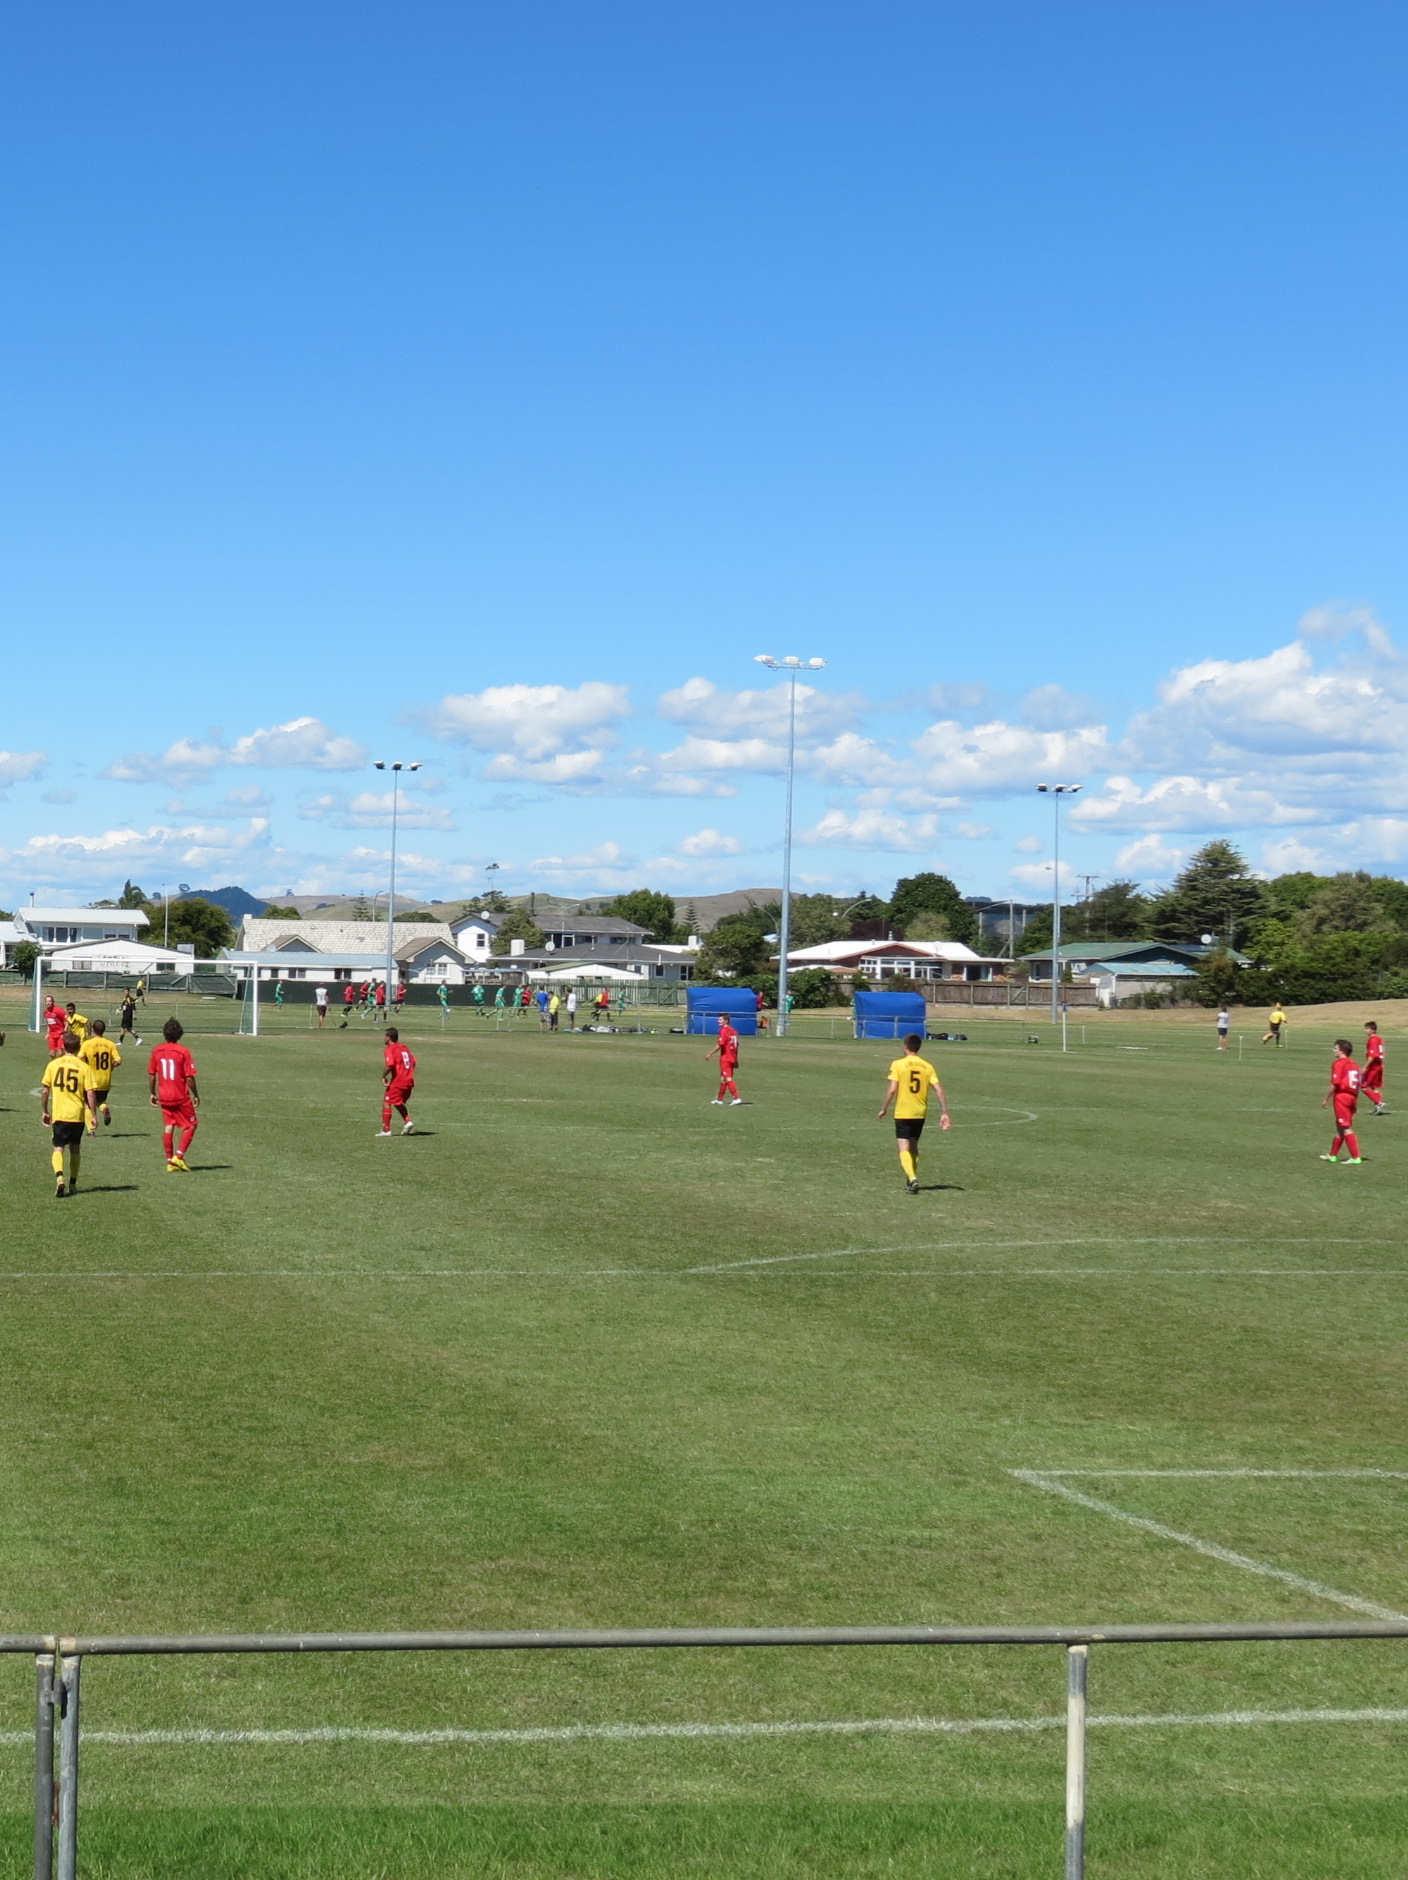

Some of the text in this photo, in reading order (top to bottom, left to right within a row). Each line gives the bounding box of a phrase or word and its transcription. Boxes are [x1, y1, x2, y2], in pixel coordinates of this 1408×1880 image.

[93, 1052, 109, 1070] 18
[160, 1058, 175, 1080] 11
[53, 1067, 79, 1093] 45
[909, 1071, 921, 1094] 5
